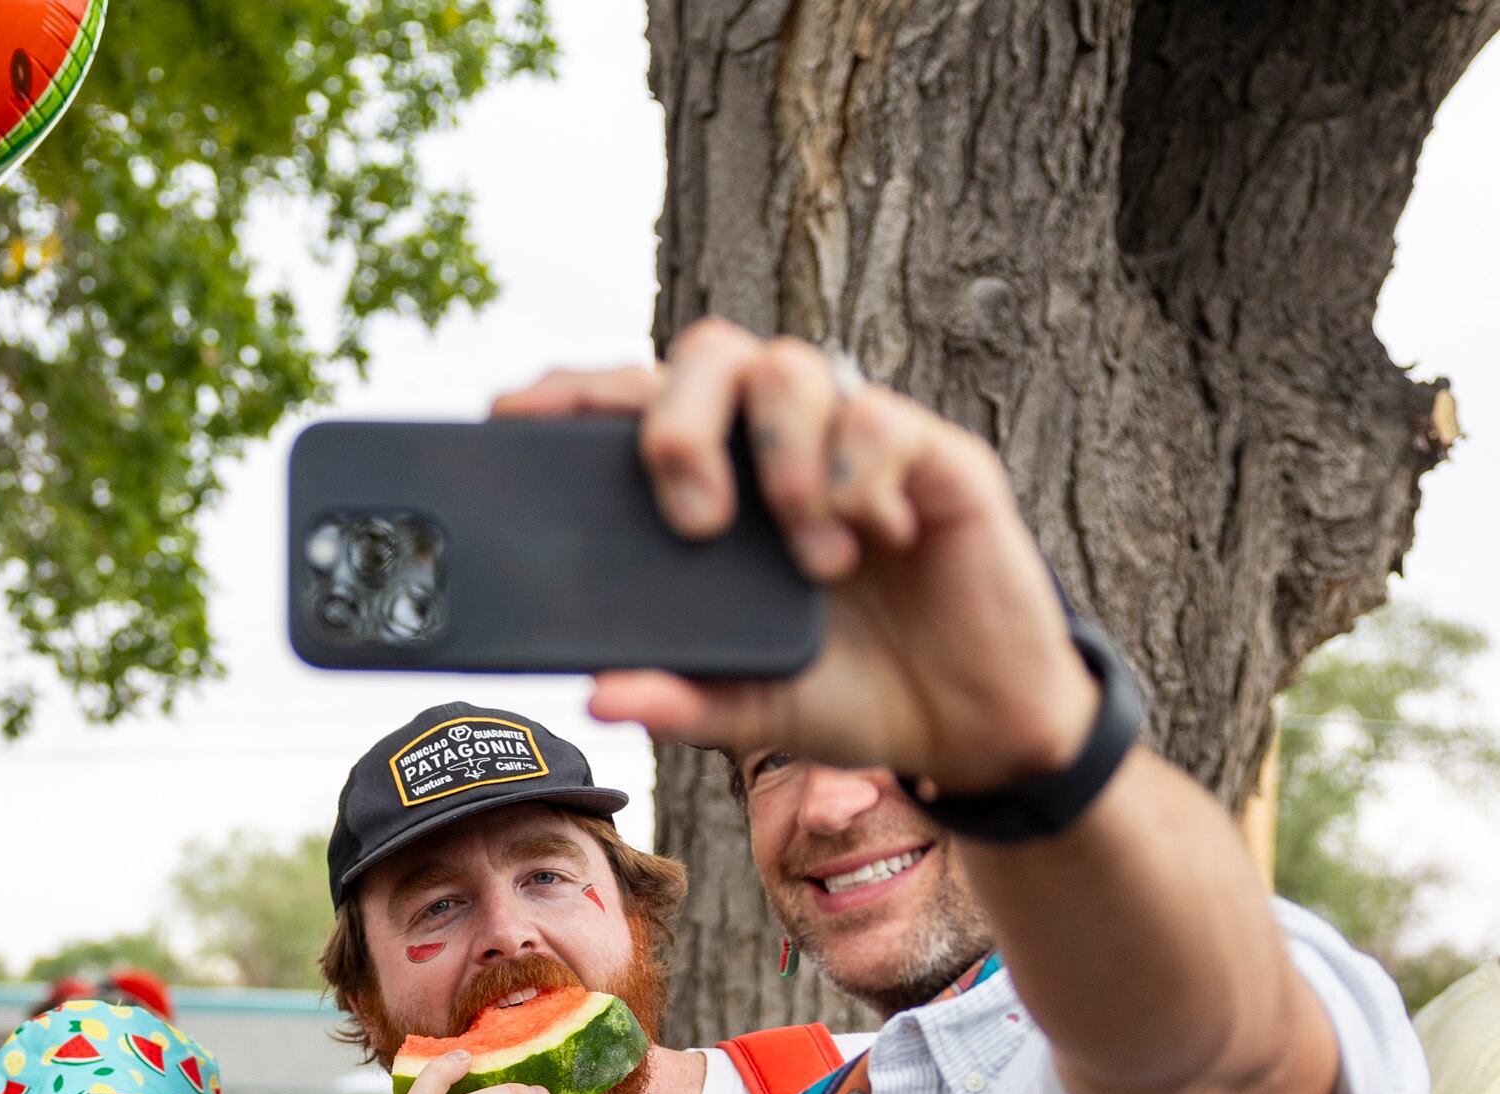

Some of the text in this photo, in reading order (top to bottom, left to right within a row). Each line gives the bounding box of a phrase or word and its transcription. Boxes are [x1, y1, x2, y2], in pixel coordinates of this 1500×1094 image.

[400, 738, 448, 767] IRONCLAD
[473, 729, 526, 741] GUARANTEE
[404, 740, 531, 782] PATAGONIA
[411, 775, 453, 796] Ventura
